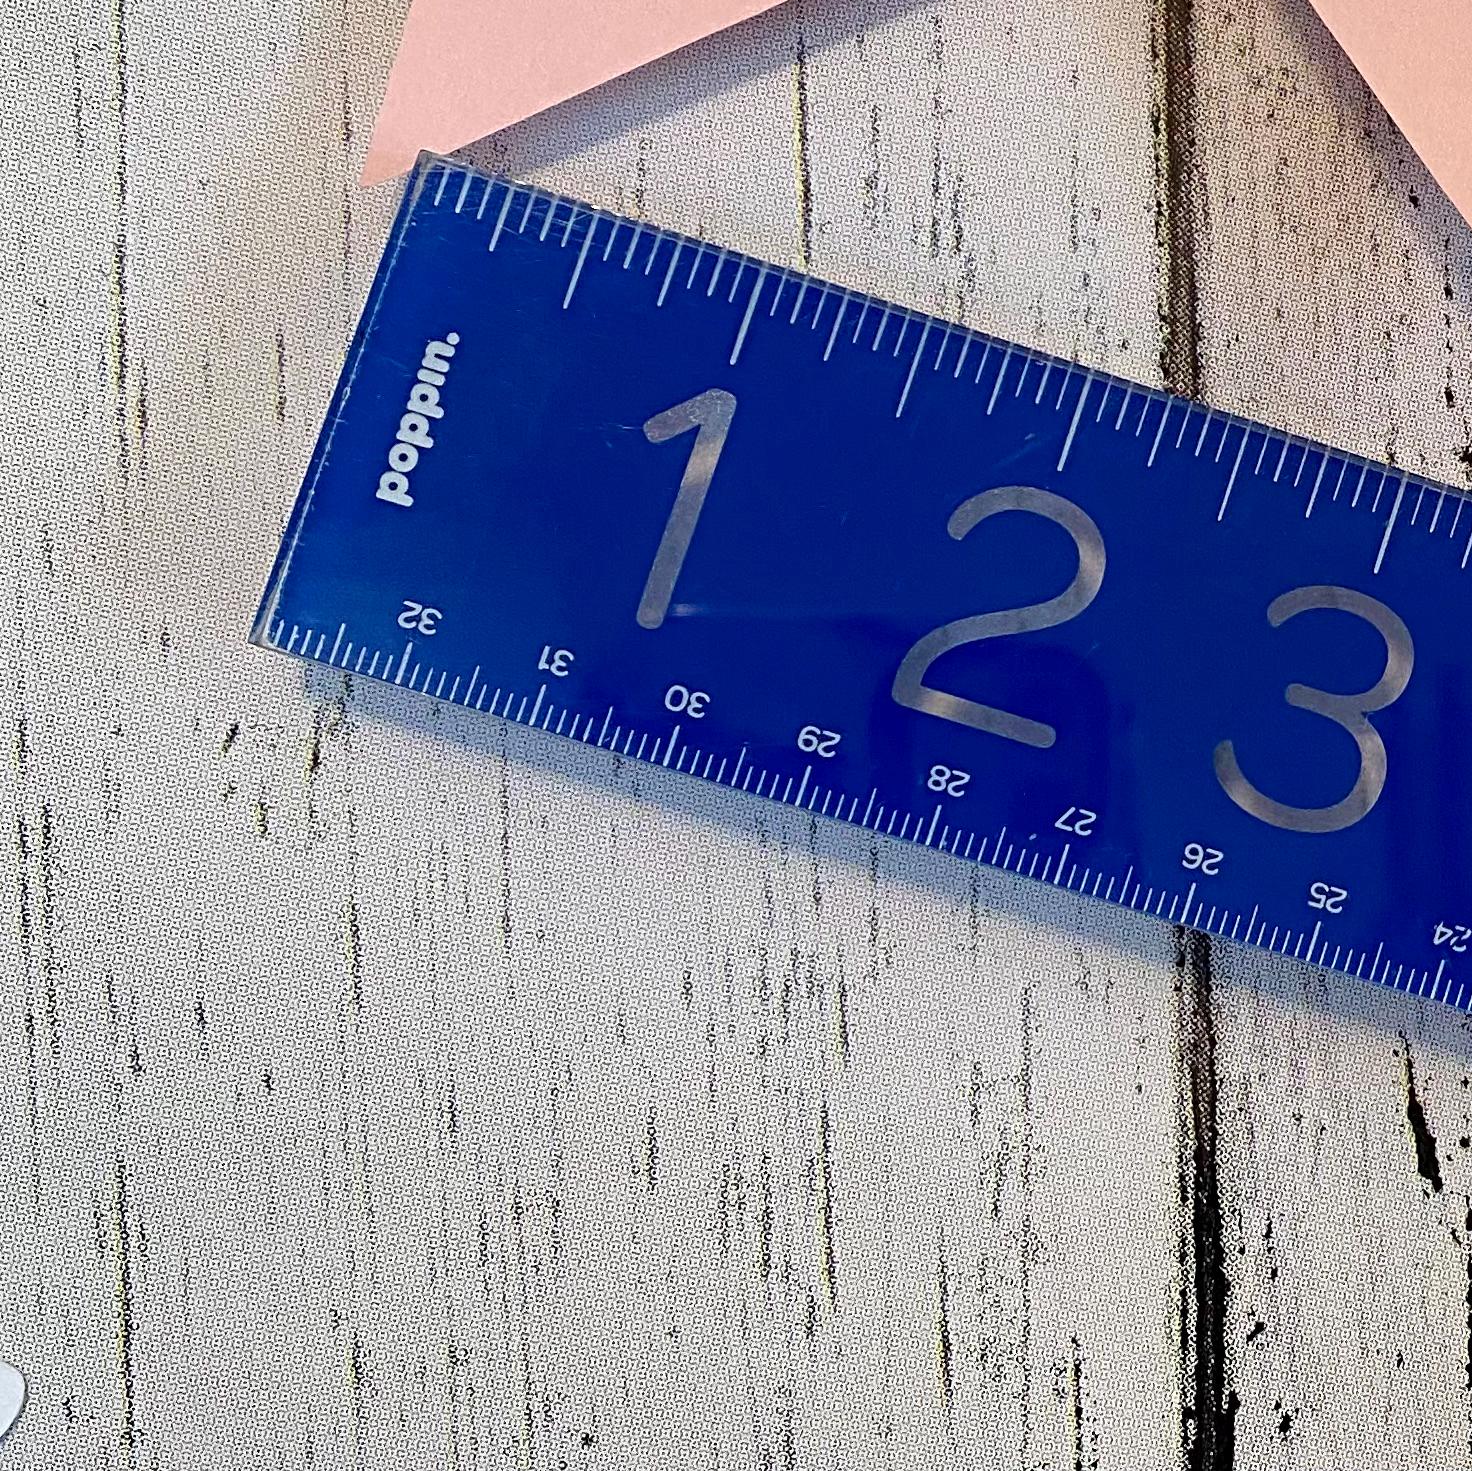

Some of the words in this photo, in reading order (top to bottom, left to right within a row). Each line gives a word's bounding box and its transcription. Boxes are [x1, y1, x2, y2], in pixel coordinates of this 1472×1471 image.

[376, 332, 460, 508] poppin.
[397, 601, 443, 635] 32
[635, 388, 737, 630] 1
[892, 485, 1106, 749] 2
[1213, 585, 1415, 833] 3
[538, 644, 575, 677] 31
[664, 684, 711, 719] 30
[797, 725, 841, 758] 29
[927, 764, 971, 798] 28
[1054, 806, 1097, 836] 27
[1181, 842, 1224, 876] 26
[1307, 881, 1348, 914] 25
[1433, 921, 1472, 953] 24
